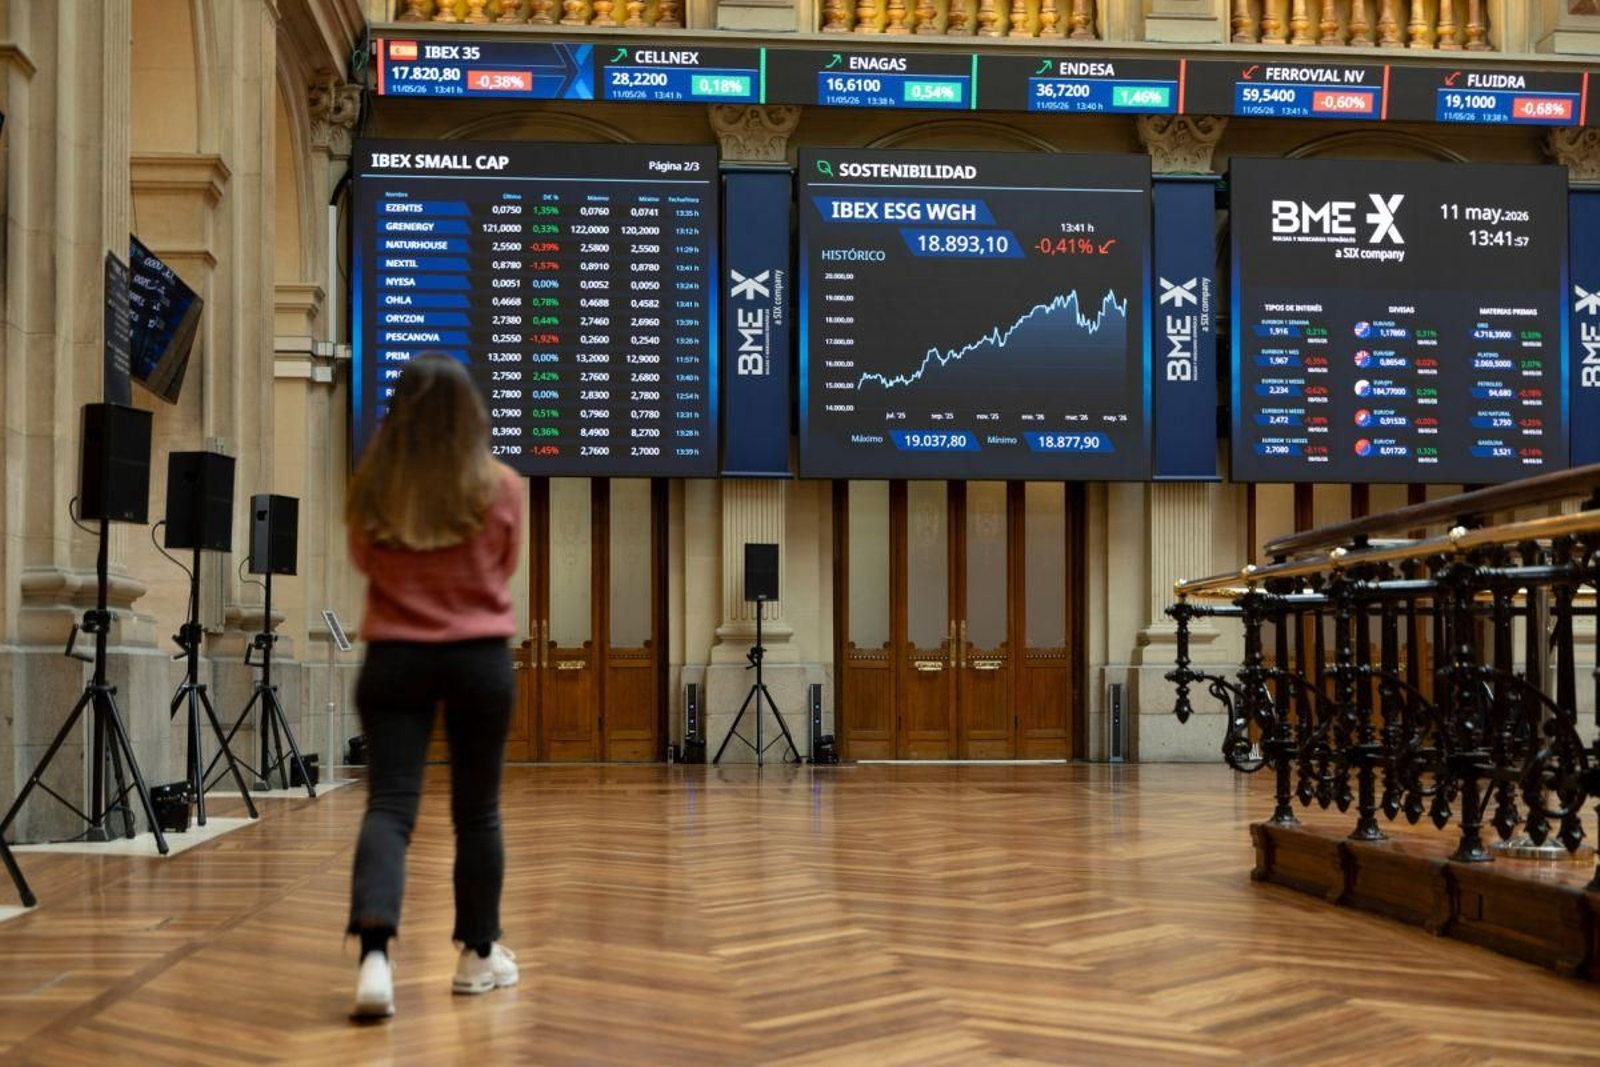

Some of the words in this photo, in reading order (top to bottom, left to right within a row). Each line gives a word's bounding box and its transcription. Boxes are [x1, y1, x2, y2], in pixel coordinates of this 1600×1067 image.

[425, 45, 460, 59] IBEX
[462, 46, 480, 60] 35
[635, 50, 699, 64] CELLNEX
[850, 57, 907, 71] ENAGAS
[1060, 62, 1115, 76] ENDESA
[392, 66, 461, 82] 17.820,80
[612, 72, 668, 87] 28,2200
[1266, 67, 1341, 83] FERROVIAL
[1344, 70, 1365, 83] NV
[1467, 74, 1525, 88] FLUIDRA
[392, 84, 427, 93] 11/05/26
[435, 86, 455, 94] 13:41
[457, 86, 463, 94] h
[474, 74, 525, 90] -0,38%
[700, 79, 742, 93] 0,18%
[827, 78, 881, 92] 16,6100
[613, 90, 647, 98] 11/05/26
[654, 91, 674, 99] 13:41
[676, 91, 682, 99] h
[912, 85, 954, 99] 0,54%
[1036, 83, 1090, 98] 36,7200
[1121, 90, 1162, 105] 1,46%
[1243, 88, 1295, 103] 59,5400
[826, 96, 861, 106] 11/05/26
[1036, 101, 1070, 111] 11/05/26
[1076, 102, 1097, 110] 13:40
[1320, 95, 1365, 110] -0,60%
[1446, 94, 1496, 109] 19,1000
[1243, 106, 1275, 115] 11/05/26
[1281, 107, 1301, 115] 13:41
[1520, 102, 1564, 116] -0,68%
[1443, 112, 1476, 122] 11/05/26
[371, 153, 411, 168] IBEX
[415, 154, 472, 169] SMALL
[475, 156, 509, 170] CAP
[649, 161, 681, 173] Página
[683, 162, 700, 171] 2/3
[839, 163, 977, 179] SOSTENIBILIDAD
[385, 203, 423, 212] EZENTIS
[492, 205, 522, 214] 0,0750
[533, 206, 559, 215] 1,35%
[580, 207, 610, 216] 0,0760
[630, 208, 658, 217] 0,0741
[832, 201, 878, 219] IBEX
[884, 202, 921, 220] ESG
[927, 203, 976, 220] WGH
[1272, 200, 1356, 234] BME
[1441, 204, 1458, 219] 11
[1465, 207, 1529, 225] may.2026
[386, 222, 434, 231] GRENERGY
[483, 224, 522, 233] 121,0000
[533, 224, 559, 233] 0,33%
[571, 225, 610, 234] 122,0000
[621, 226, 660, 235] 120,2000
[1061, 223, 1084, 232] 13:41
[1087, 223, 1094, 232] h
[918, 235, 1008, 254] 18.893,10
[1469, 230, 1529, 247] 13:41:57
[385, 240, 447, 250] NATURHOUSE
[492, 242, 522, 251] 2,5500
[531, 243, 559, 251] -0,39%
[580, 243, 610, 253] 2,5800
[631, 244, 660, 253] 2,5500
[1035, 238, 1094, 255] -0,41%
[822, 248, 886, 261] HISTÓRICO
[1335, 249, 1342, 258] a
[1343, 247, 1359, 258] SIX
[1360, 250, 1405, 262] company
[386, 259, 418, 267] NEXTIL
[531, 261, 559, 270] -1,57%
[580, 262, 610, 271] 0,8910
[386, 277, 416, 286] NYESA
[492, 279, 520, 288] 0,0051
[533, 279, 559, 288] 0,00%
[580, 280, 609, 289] 0,0052
[630, 281, 660, 290] 0,0050
[774, 269, 784, 305] company
[1202, 277, 1211, 312] company
[385, 296, 412, 304] OHLA
[533, 298, 559, 307] 0,78%
[631, 299, 659, 308] 0,4582
[773, 306, 782, 319] SIX
[1201, 313, 1210, 325] SIX
[1512, 308, 1538, 316] PRIMAS
[385, 314, 424, 323] ORYZON
[533, 316, 559, 325] 0,44%
[385, 333, 440, 341] PESCANOVA
[492, 334, 522, 343] 0,2550
[531, 335, 559, 343] -1,92%
[580, 335, 610, 344] 0,2600
[631, 336, 660, 345] 0,2540
[738, 309, 763, 375] BME
[1166, 316, 1191, 381] BME
[1581, 322, 1600, 387] BME
[385, 351, 410, 360] PRIM
[488, 353, 522, 362] 13,2000
[533, 353, 559, 363] 0,00%
[576, 354, 610, 363] 13,2000
[627, 354, 660, 363] 12,9000
[492, 371, 522, 380] 2,7500
[533, 372, 559, 381] 2,42%
[580, 372, 610, 381] 2,7600
[631, 373, 660, 382] 2,6800
[492, 390, 522, 399] 2,7800
[533, 391, 559, 399] 0,00%
[580, 391, 610, 400] 2,8300
[631, 391, 660, 400] 2,7800
[492, 408, 522, 418] 0,7900
[533, 409, 559, 418] 0,51%
[631, 410, 660, 419] 0,7780
[492, 427, 522, 436] 8,3900
[533, 428, 559, 436] 0,36%
[580, 428, 610, 437] 8,4900
[631, 429, 660, 437] 8,2700
[851, 435, 883, 443] Máximo
[905, 434, 966, 448] 19.037,80
[987, 436, 1017, 444] Mínimo
[1039, 436, 1100, 450] 18.877,90
[491, 446, 522, 457] 2,7100
[530, 446, 559, 455] -1,45%
[581, 446, 610, 456] 2,7600
[631, 447, 660, 456] 2,7000
